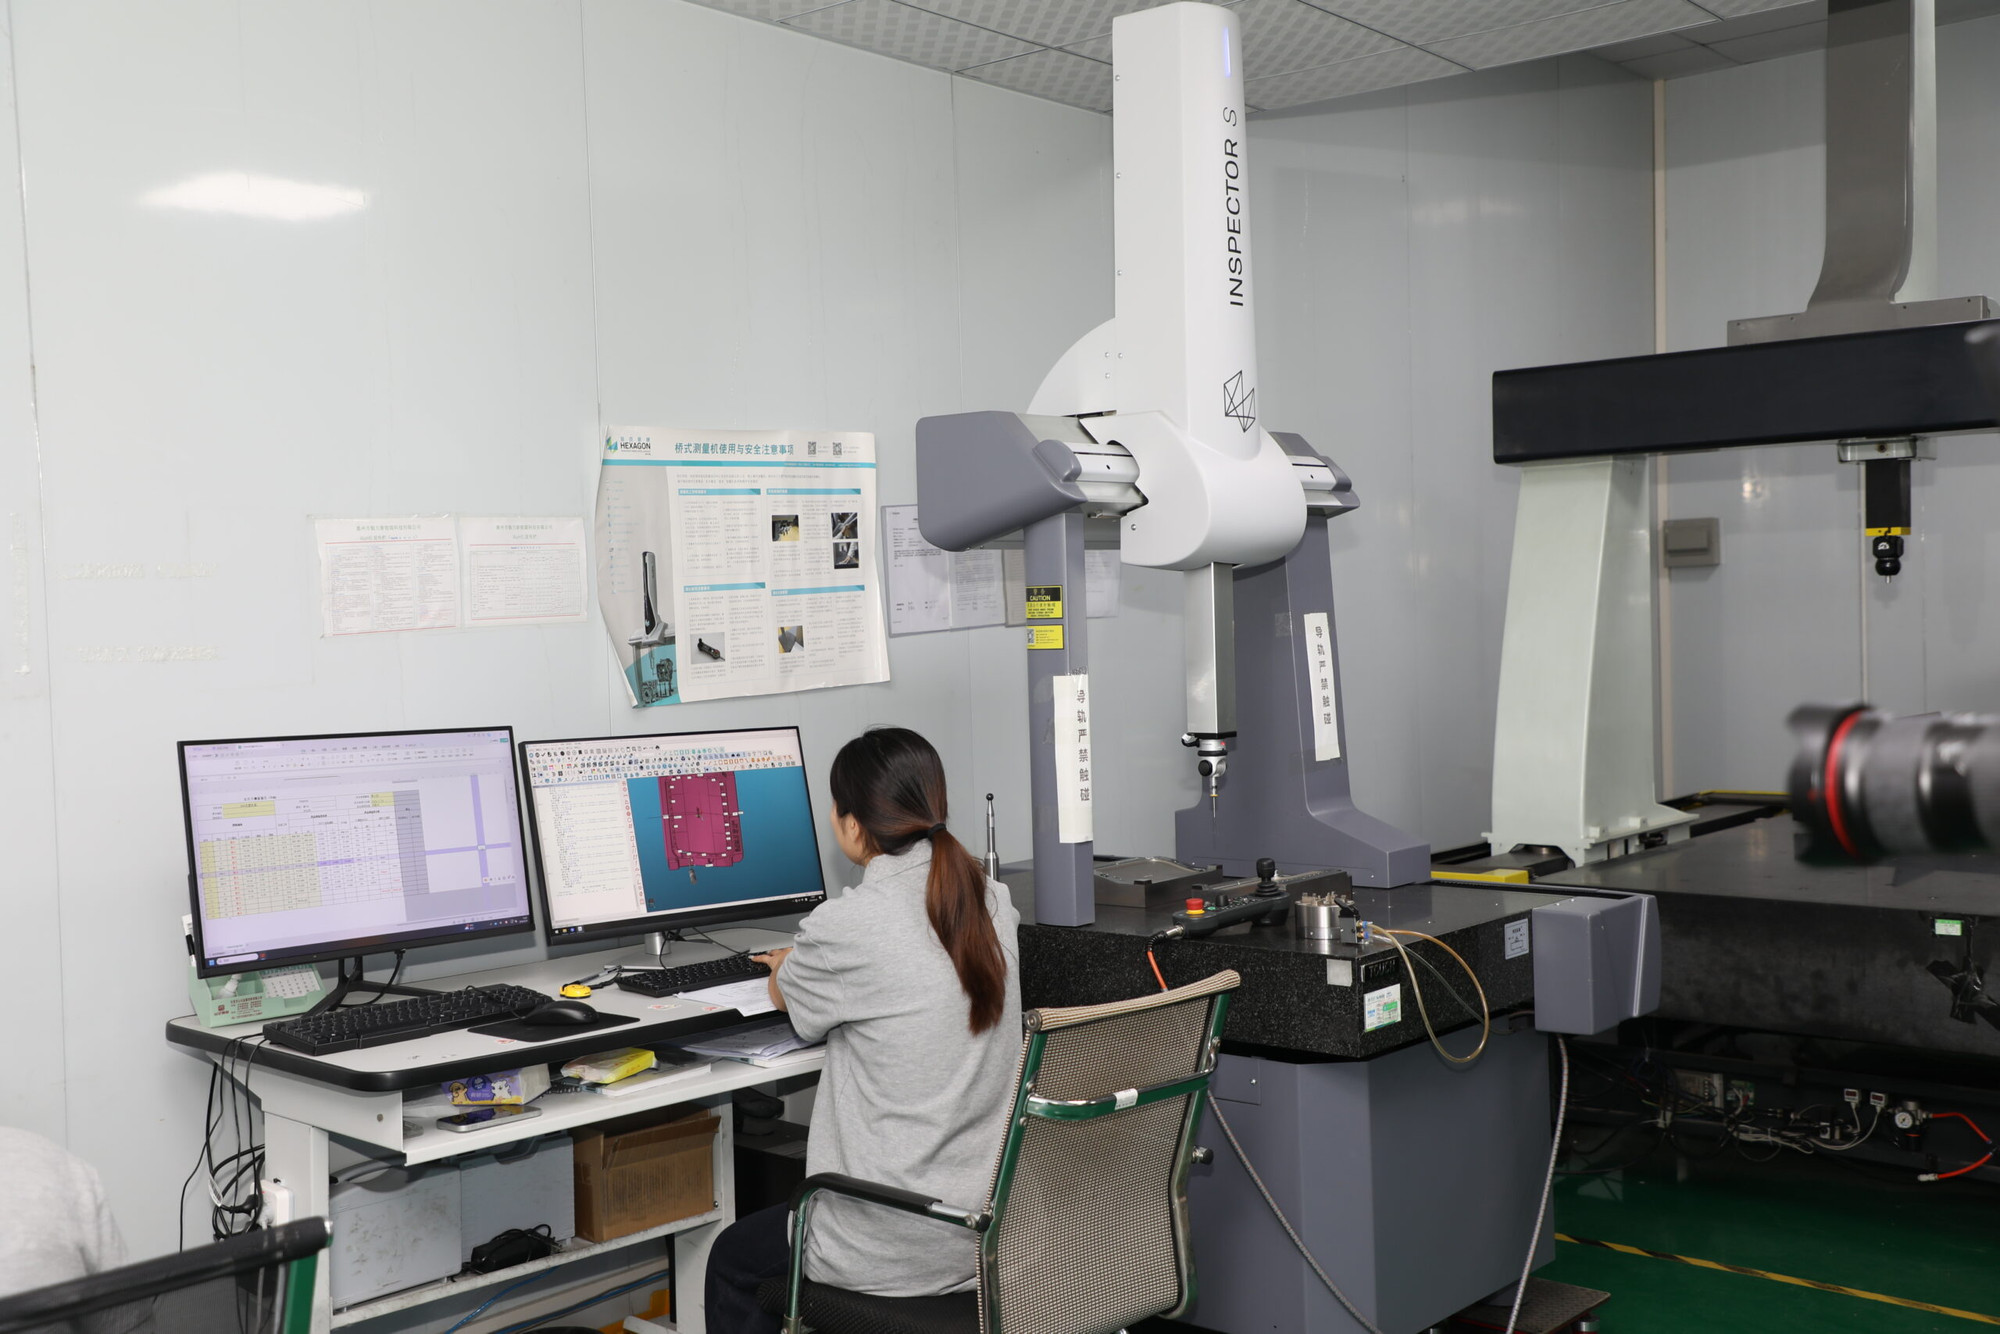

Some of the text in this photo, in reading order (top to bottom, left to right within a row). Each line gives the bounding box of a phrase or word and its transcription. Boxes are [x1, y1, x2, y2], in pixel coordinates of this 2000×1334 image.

[1223, 106, 1243, 306] INSPECTOR S
[620, 441, 651, 450] HEXAGON
[674, 442, 794, 456] 桥式测量机使用与安全注意事项
